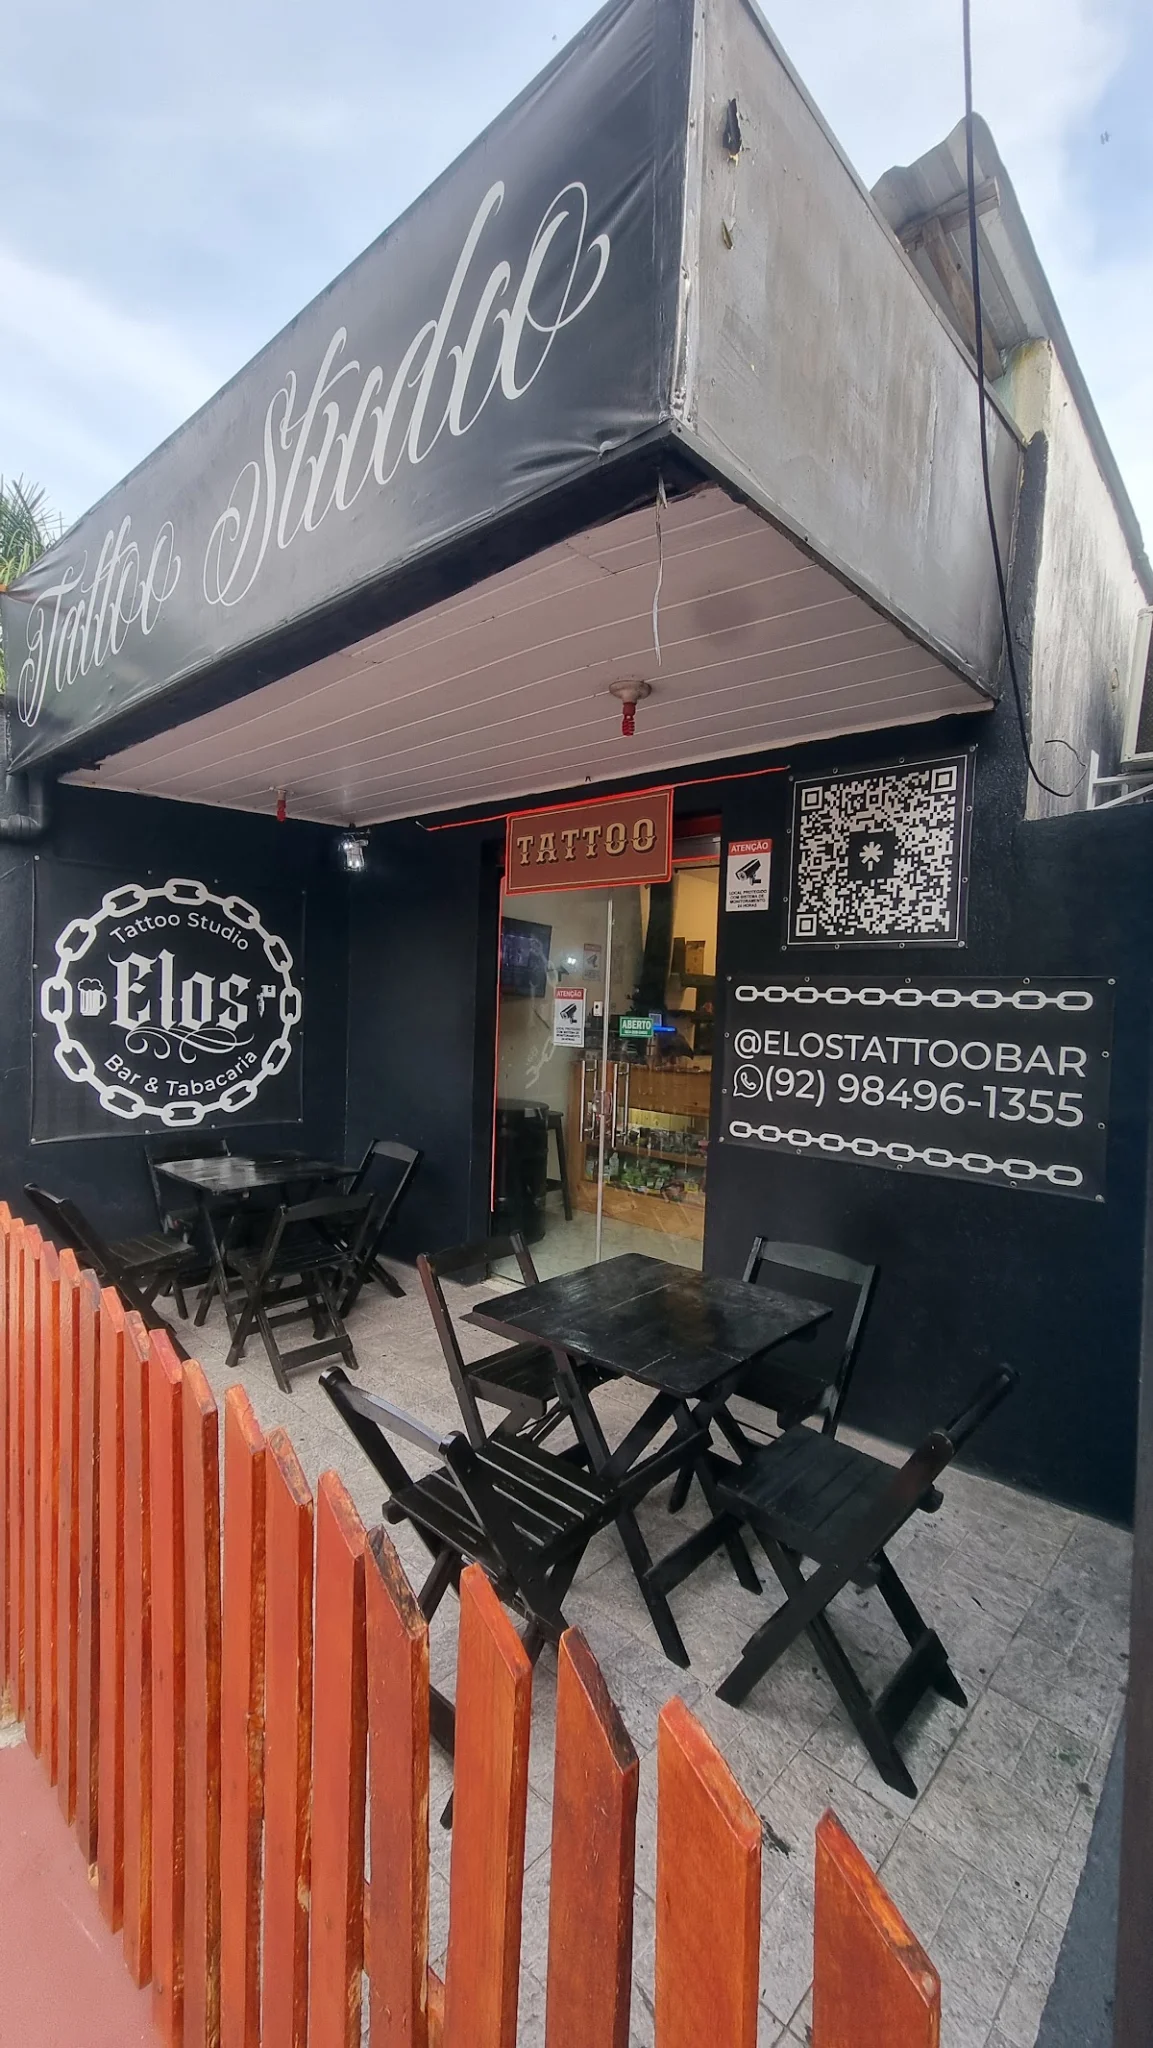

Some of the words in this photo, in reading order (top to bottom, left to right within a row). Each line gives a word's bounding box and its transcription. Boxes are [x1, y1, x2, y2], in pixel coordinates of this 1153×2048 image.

[17, 515, 181, 727] Tattoo
[203, 180, 610, 607] Studio
[516, 818, 658, 866] TATTOO
[731, 842, 768, 852] ATENÇÃO
[109, 914, 181, 944] Tattoo
[187, 912, 249, 950] Studio
[107, 948, 252, 1032] Elos
[556, 989, 582, 998] ATENÇÃO
[622, 1019, 652, 1030] ABERTO
[103, 1053, 142, 1086] Bar
[144, 1077, 159, 1094] &
[166, 1051, 258, 1097] Tabacaria
[734, 1028, 1087, 1078] @ELOSTATTOOBAR
[765, 1065, 826, 1108] (92)
[837, 1072, 1084, 1128] 98496-1355
